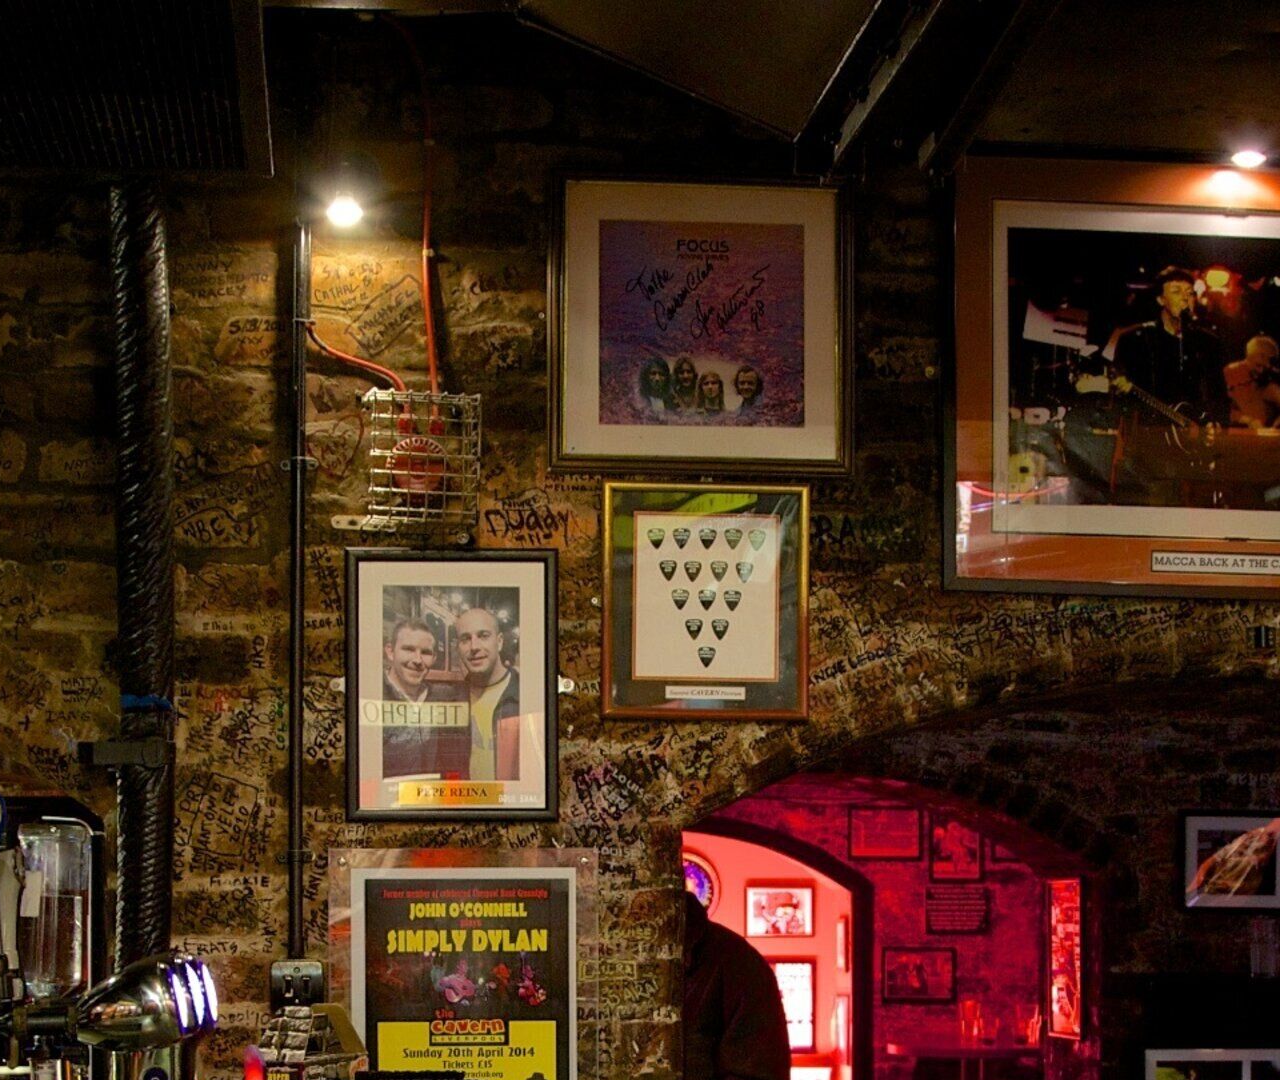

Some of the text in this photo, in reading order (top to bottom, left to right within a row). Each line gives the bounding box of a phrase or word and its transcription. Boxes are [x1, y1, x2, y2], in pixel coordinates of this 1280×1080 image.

[676, 239, 729, 253] FOCUS
[1154, 556, 1196, 567] MACCA
[1199, 557, 1229, 568] BACK
[1231, 558, 1247, 568] AT
[1248, 558, 1269, 569] THE
[417, 787, 487, 798] PEPE REINA
[409, 902, 528, 921] JOHN O'CONNELL
[387, 928, 549, 954] SIMPLY DYLAN
[435, 1009, 455, 1018] the
[430, 1018, 505, 1035] cavern
[402, 1047, 536, 1059] Sunday 20th April 2014
[442, 1060, 474, 1069] Tickets
